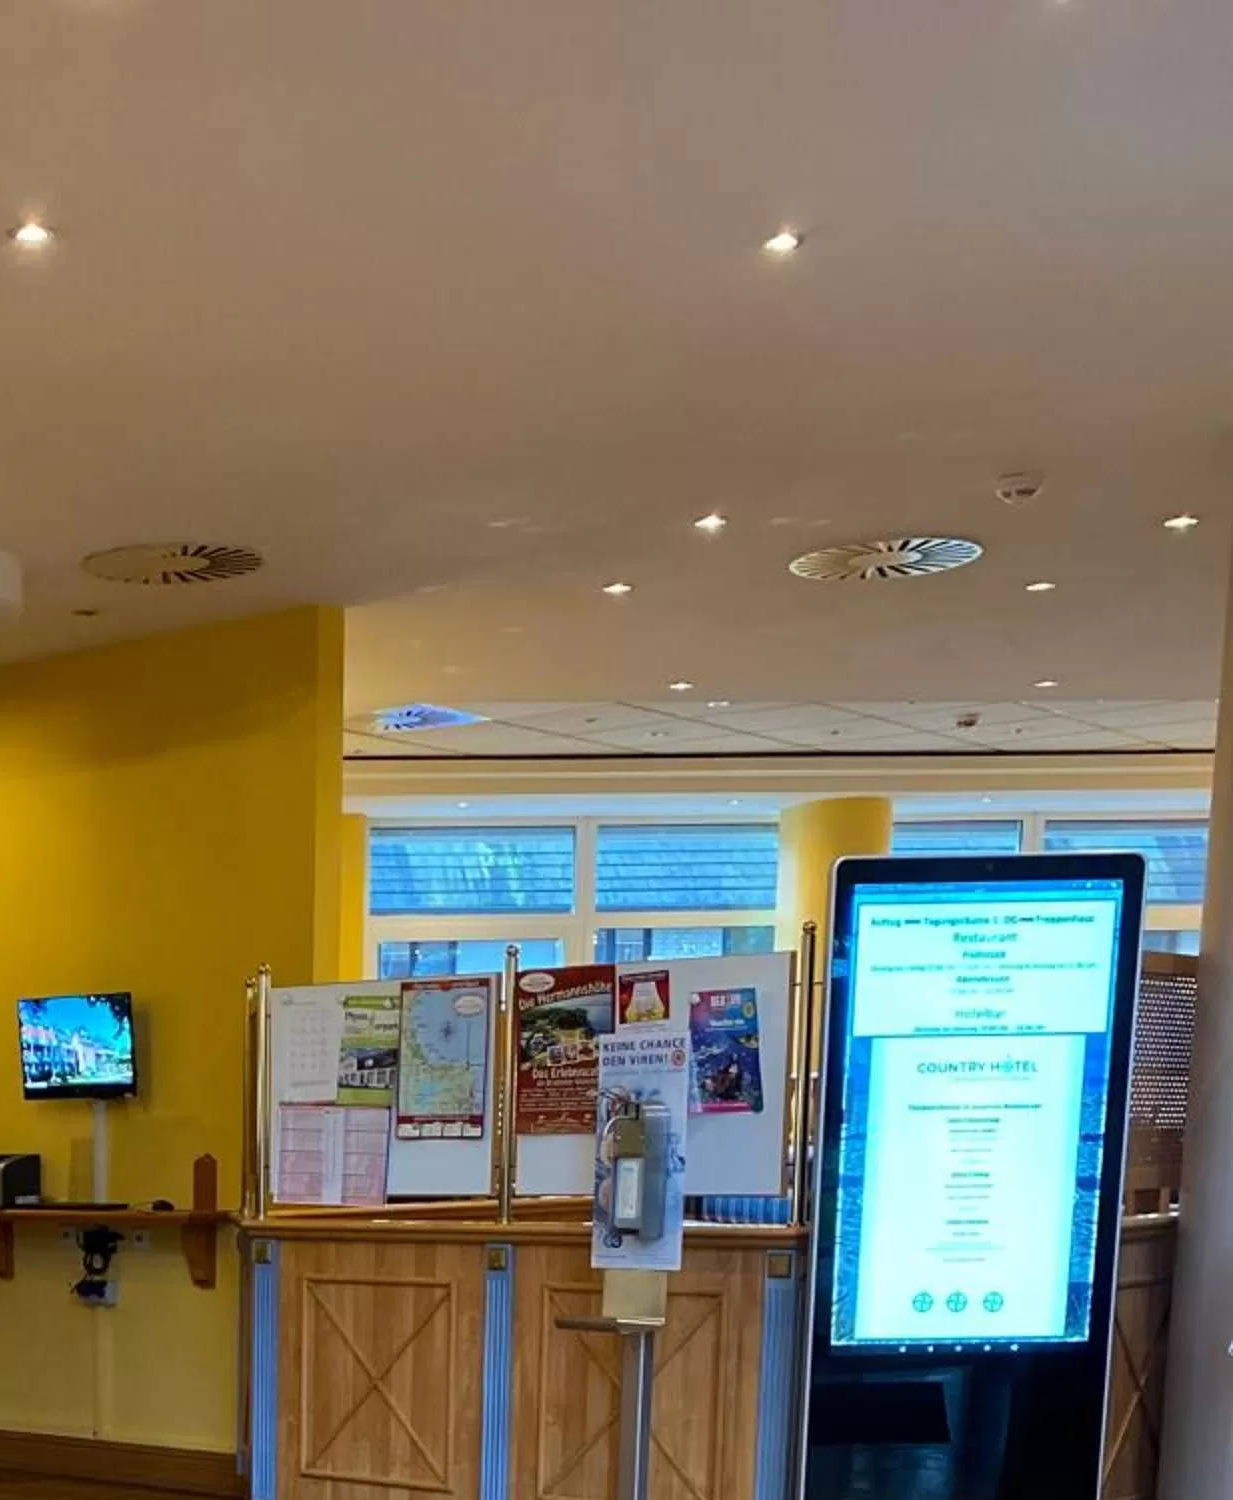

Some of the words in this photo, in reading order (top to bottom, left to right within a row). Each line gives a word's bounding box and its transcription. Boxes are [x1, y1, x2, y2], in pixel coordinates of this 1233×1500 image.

[953, 931, 1018, 943] Restaurant
[602, 1041, 636, 1053] KEINE
[639, 1038, 687, 1050] CHANCE
[602, 1055, 626, 1067] DEN
[628, 1053, 669, 1065] VIREN!
[917, 1061, 985, 1074] COUNTRY
[990, 1059, 1039, 1073] HOTEL
